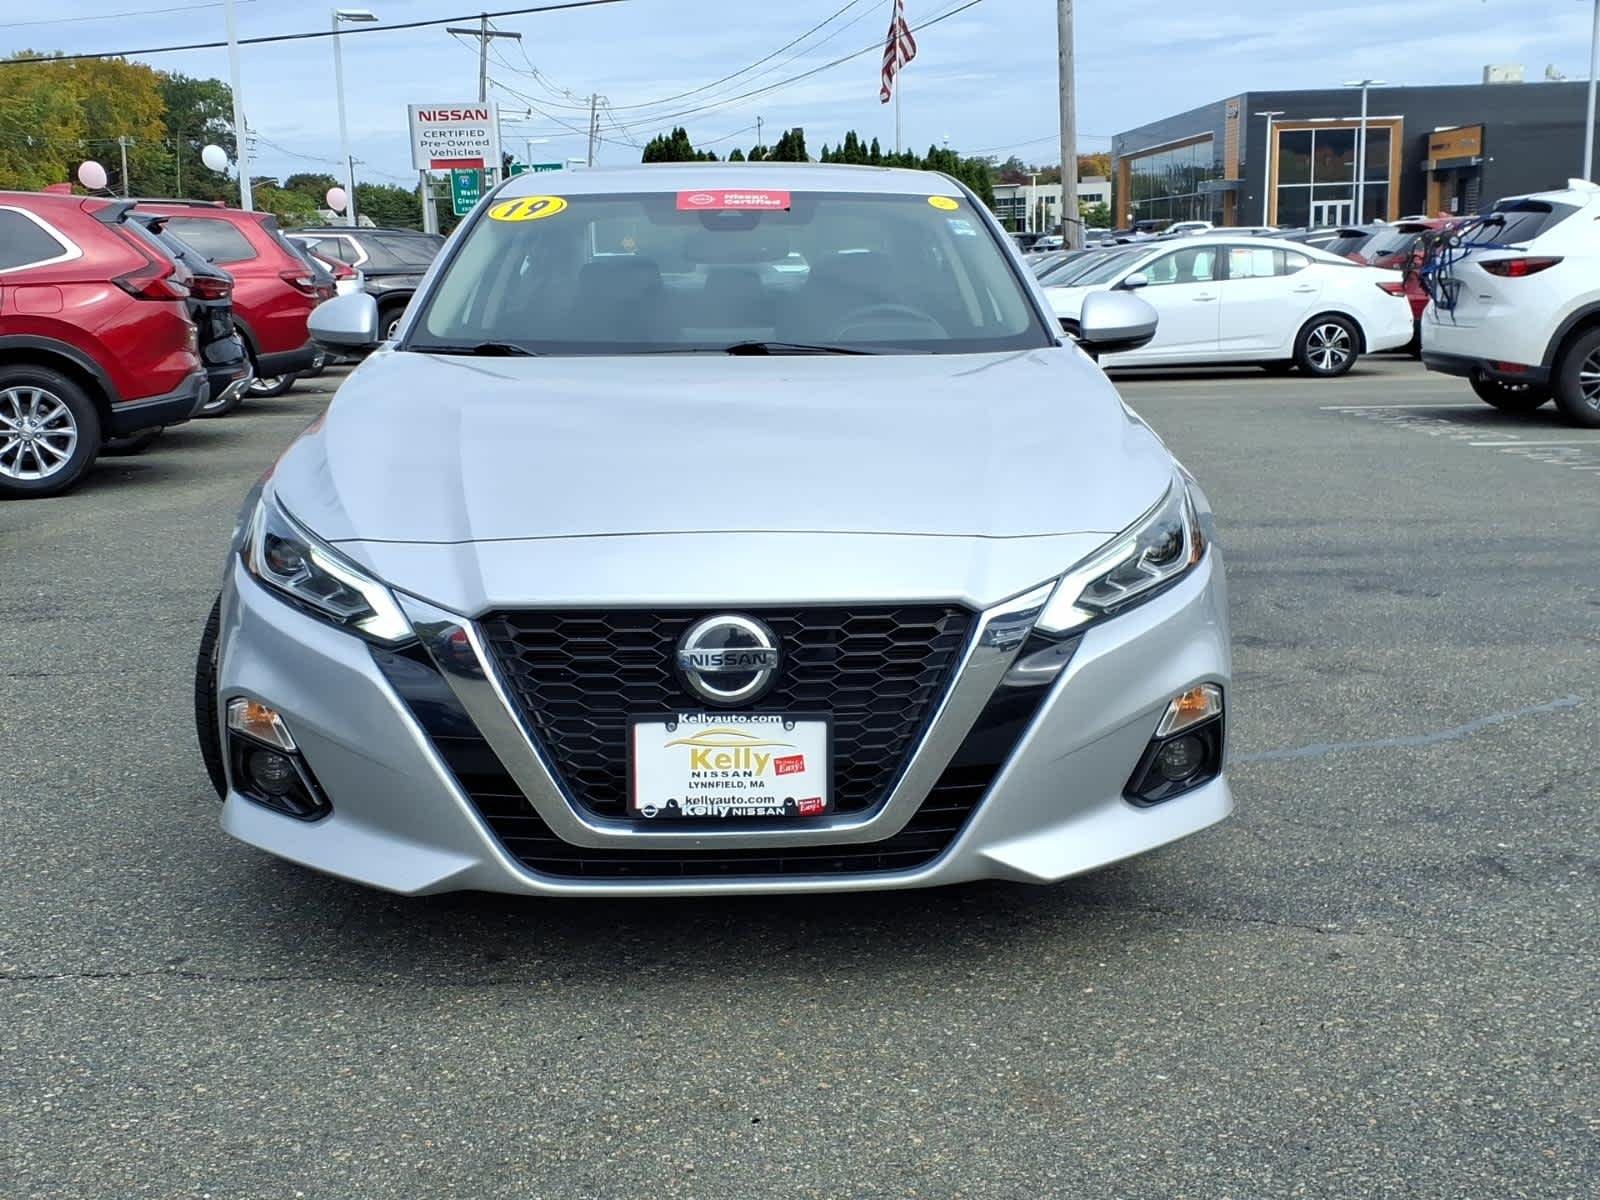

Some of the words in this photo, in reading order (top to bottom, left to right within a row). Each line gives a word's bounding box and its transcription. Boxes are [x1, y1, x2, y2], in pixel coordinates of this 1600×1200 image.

[418, 109, 488, 121] NISSAN
[423, 129, 485, 138] CERTIFIED
[420, 139, 490, 147] Pre-Owned
[429, 149, 481, 157] Vehicles
[502, 200, 551, 217] 19
[689, 653, 767, 666] NISSAN
[678, 712, 782, 725] Kellyauto.com
[690, 748, 770, 776] Kelly
[691, 770, 753, 778] NISSAN
[688, 781, 747, 789] LYNNFIELD,
[685, 795, 775, 806] kellyauto.com
[681, 805, 729, 818] Kelly
[732, 807, 786, 816] NISSAN
